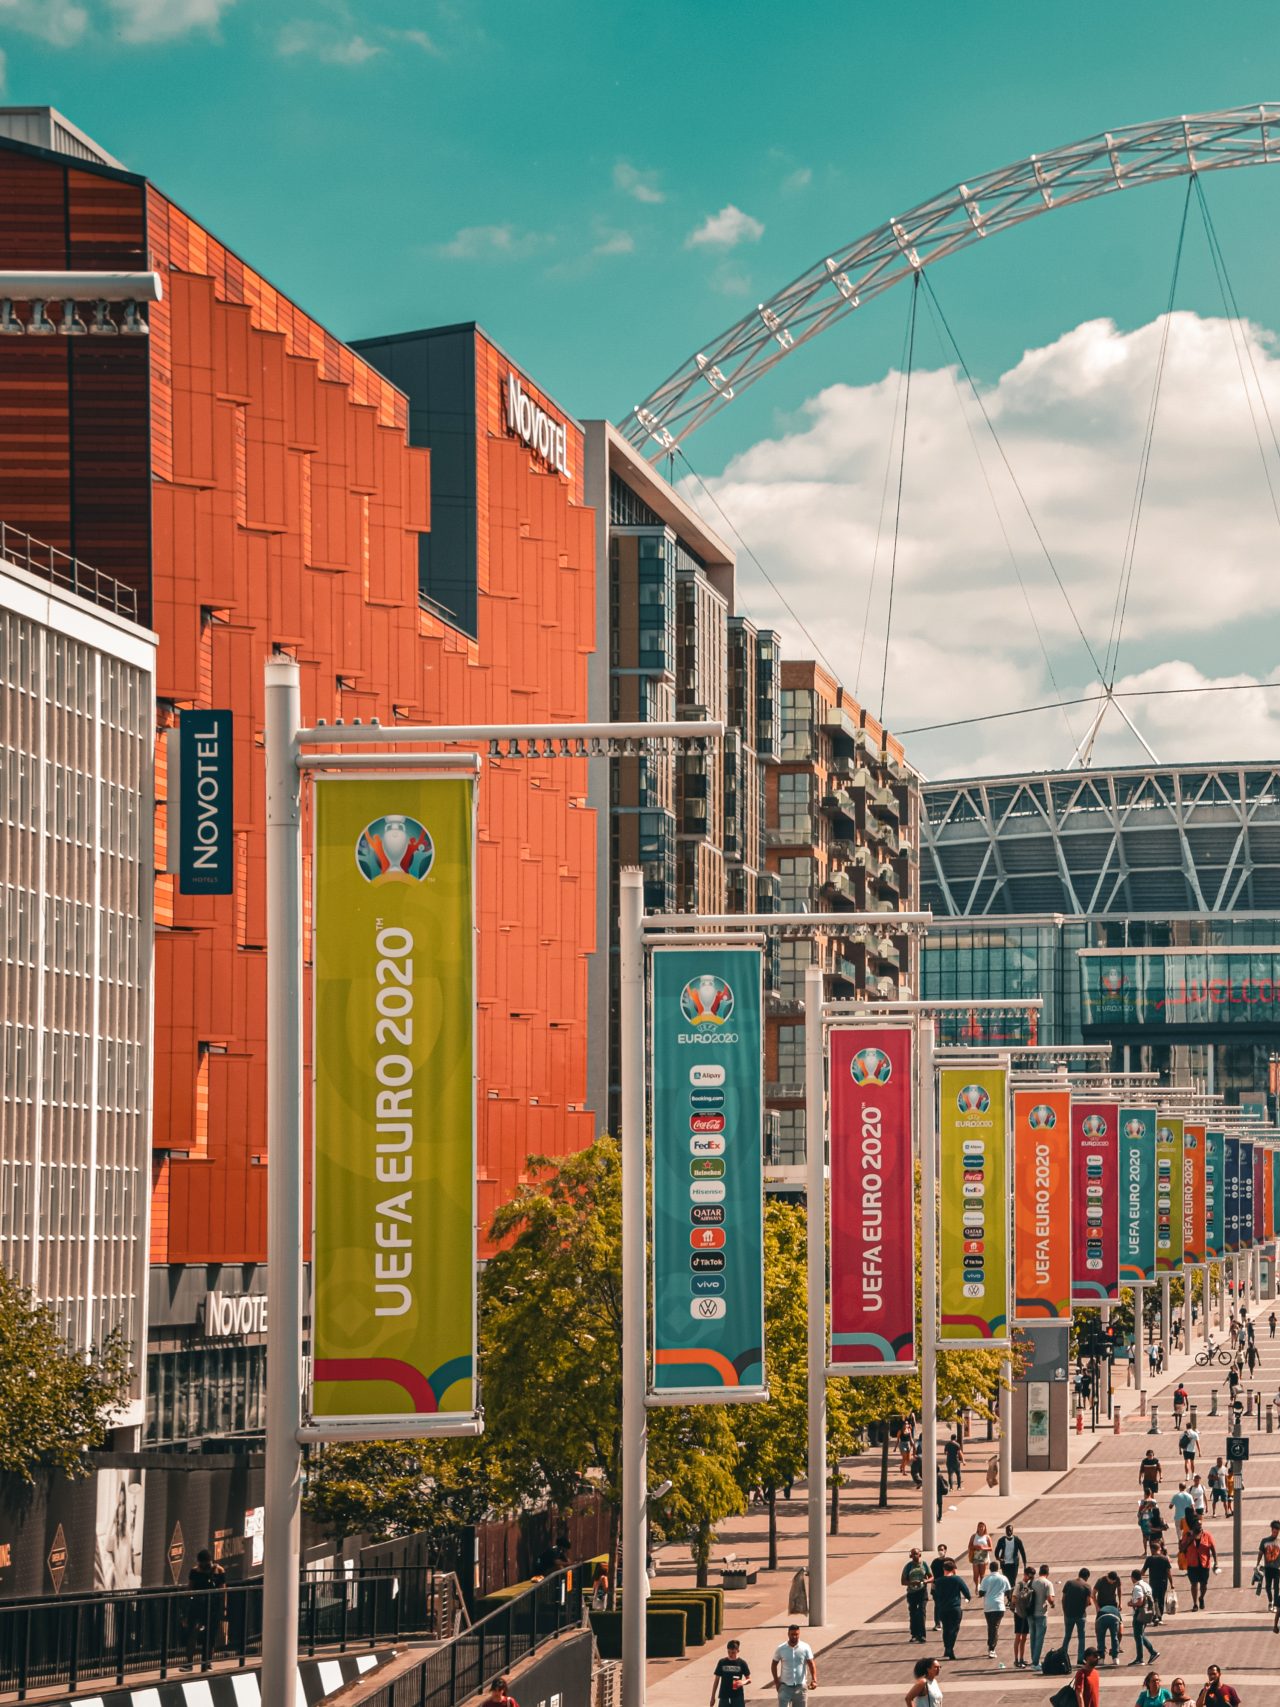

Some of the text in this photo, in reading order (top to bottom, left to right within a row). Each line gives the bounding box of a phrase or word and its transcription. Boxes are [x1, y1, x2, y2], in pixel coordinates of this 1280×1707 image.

[508, 372, 571, 479] NOVOTEL
[193, 721, 219, 869] NOVOTEL
[677, 1032, 739, 1044] EURO2020
[702, 1072, 721, 1080] Alipay
[375, 1053, 414, 1183] EURO
[694, 1140, 721, 1150] FedEx
[861, 1106, 882, 1170] 2020
[693, 1209, 722, 1217] QATAR
[862, 1173, 882, 1242] EURO
[1035, 1144, 1050, 1285] UEFA EURO 2020
[1128, 1148, 1140, 1255] UEFA EURO 2020
[1184, 1158, 1194, 1244] UEFA EURO 2020
[375, 1190, 414, 1317] UEFA
[862, 1245, 882, 1312] UEFA
